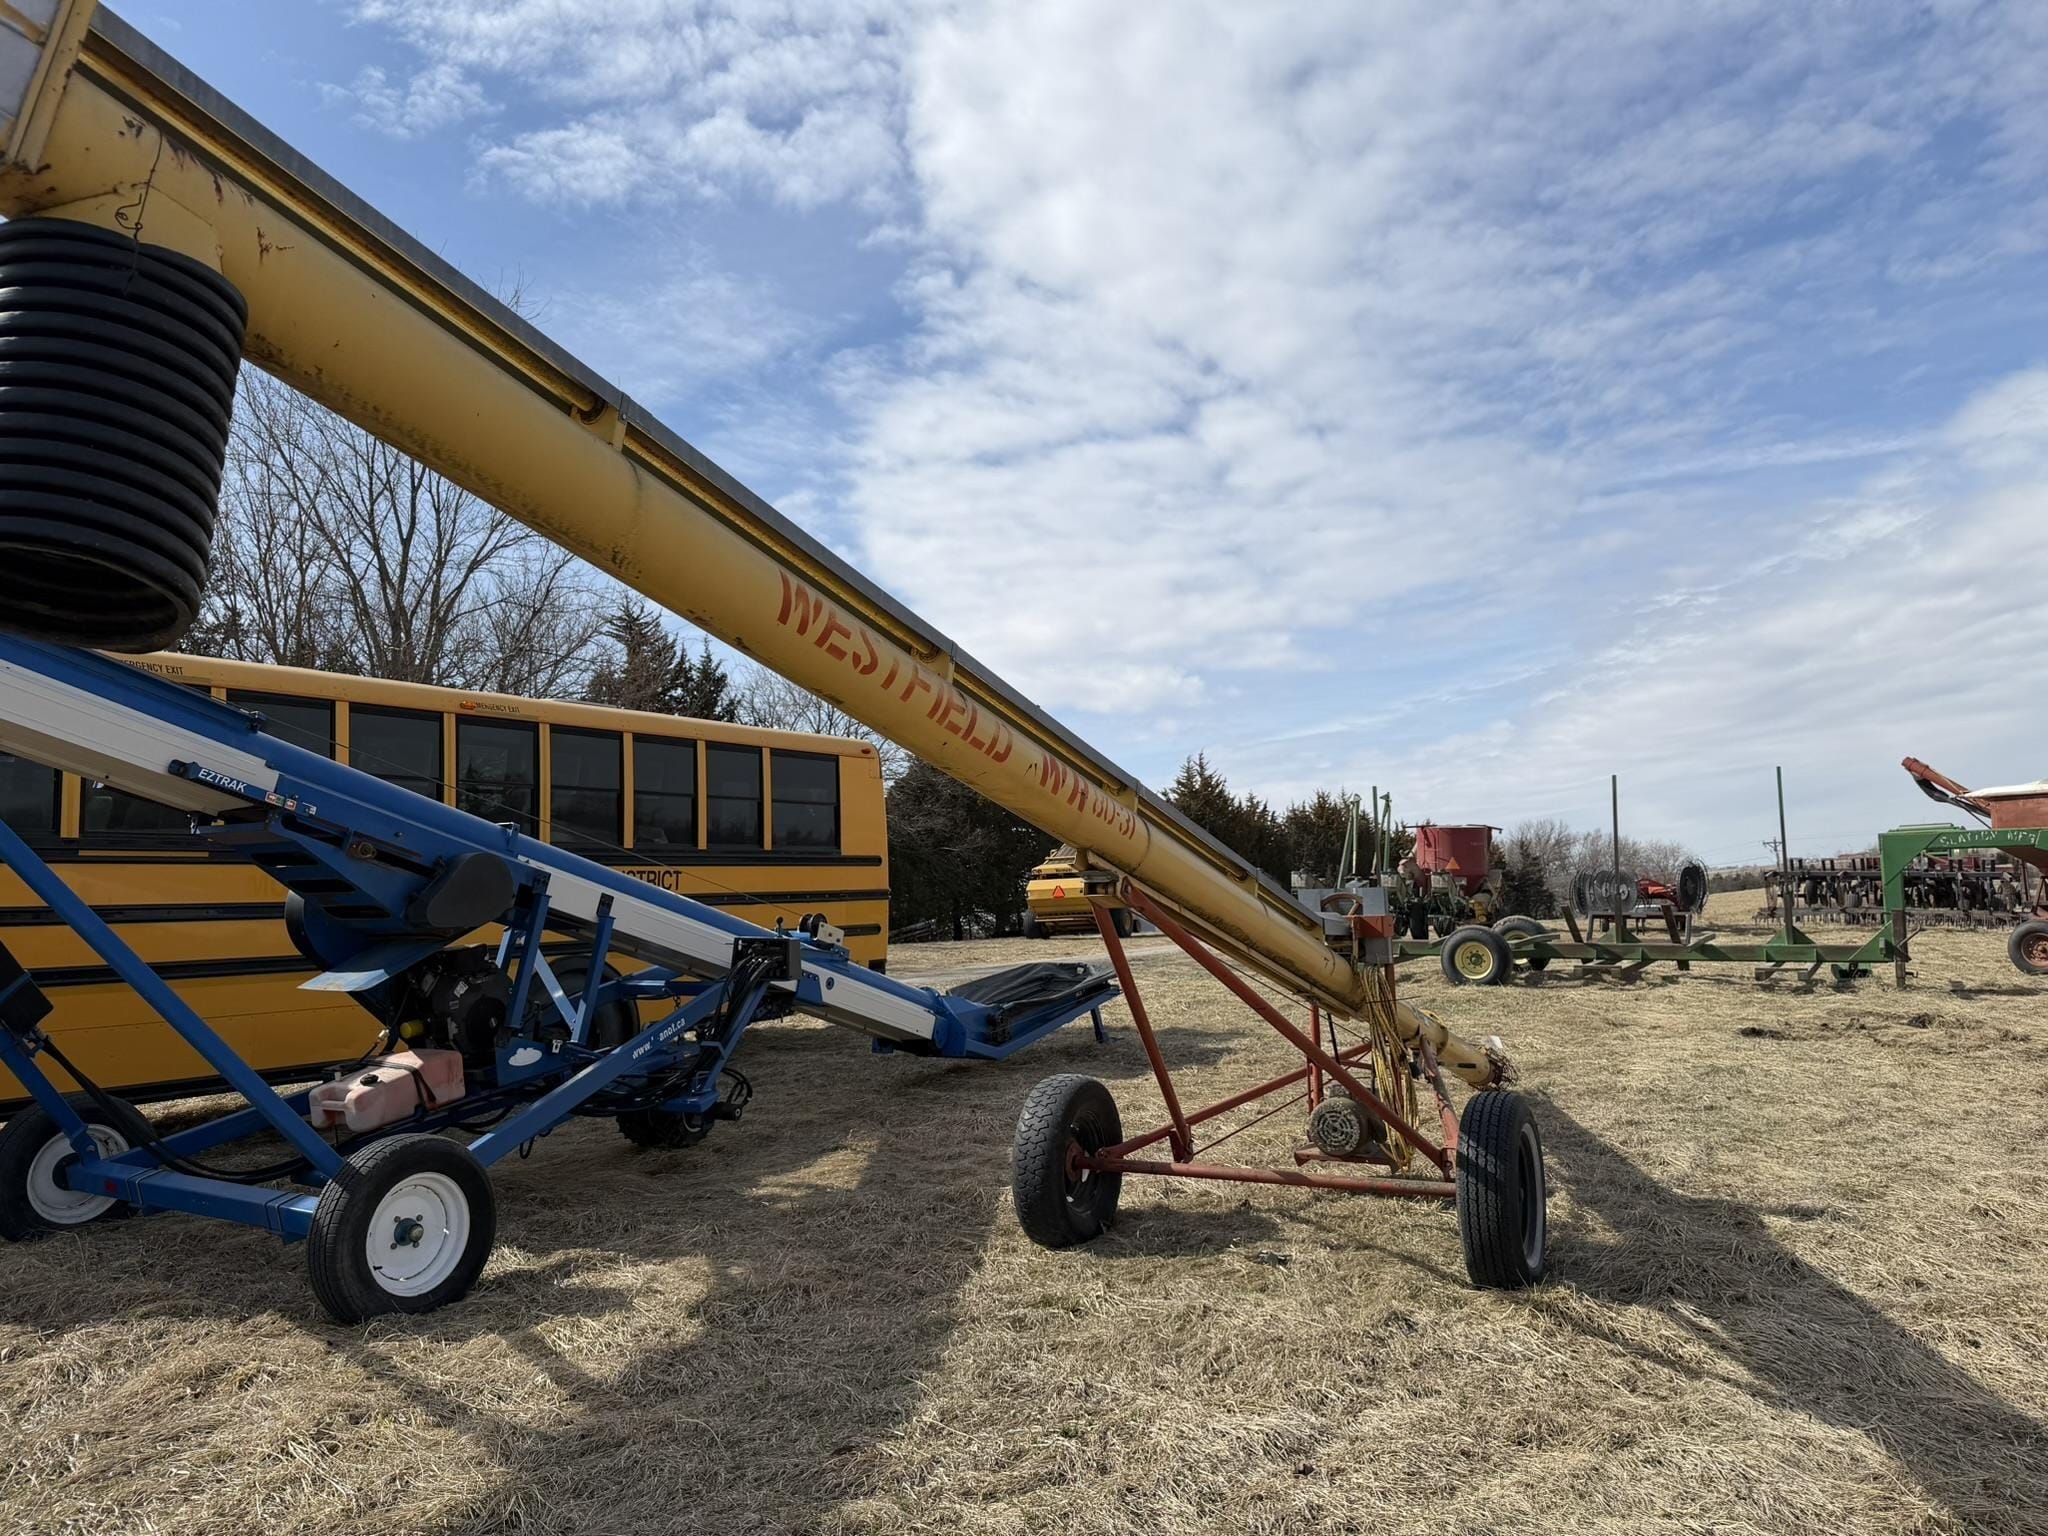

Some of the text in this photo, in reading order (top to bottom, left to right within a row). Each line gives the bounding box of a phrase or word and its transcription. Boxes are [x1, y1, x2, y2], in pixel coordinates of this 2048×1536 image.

[165, 664, 183, 675] EXIT
[776, 566, 1013, 764] WESTFIELD
[199, 768, 247, 793] EZTRAK
